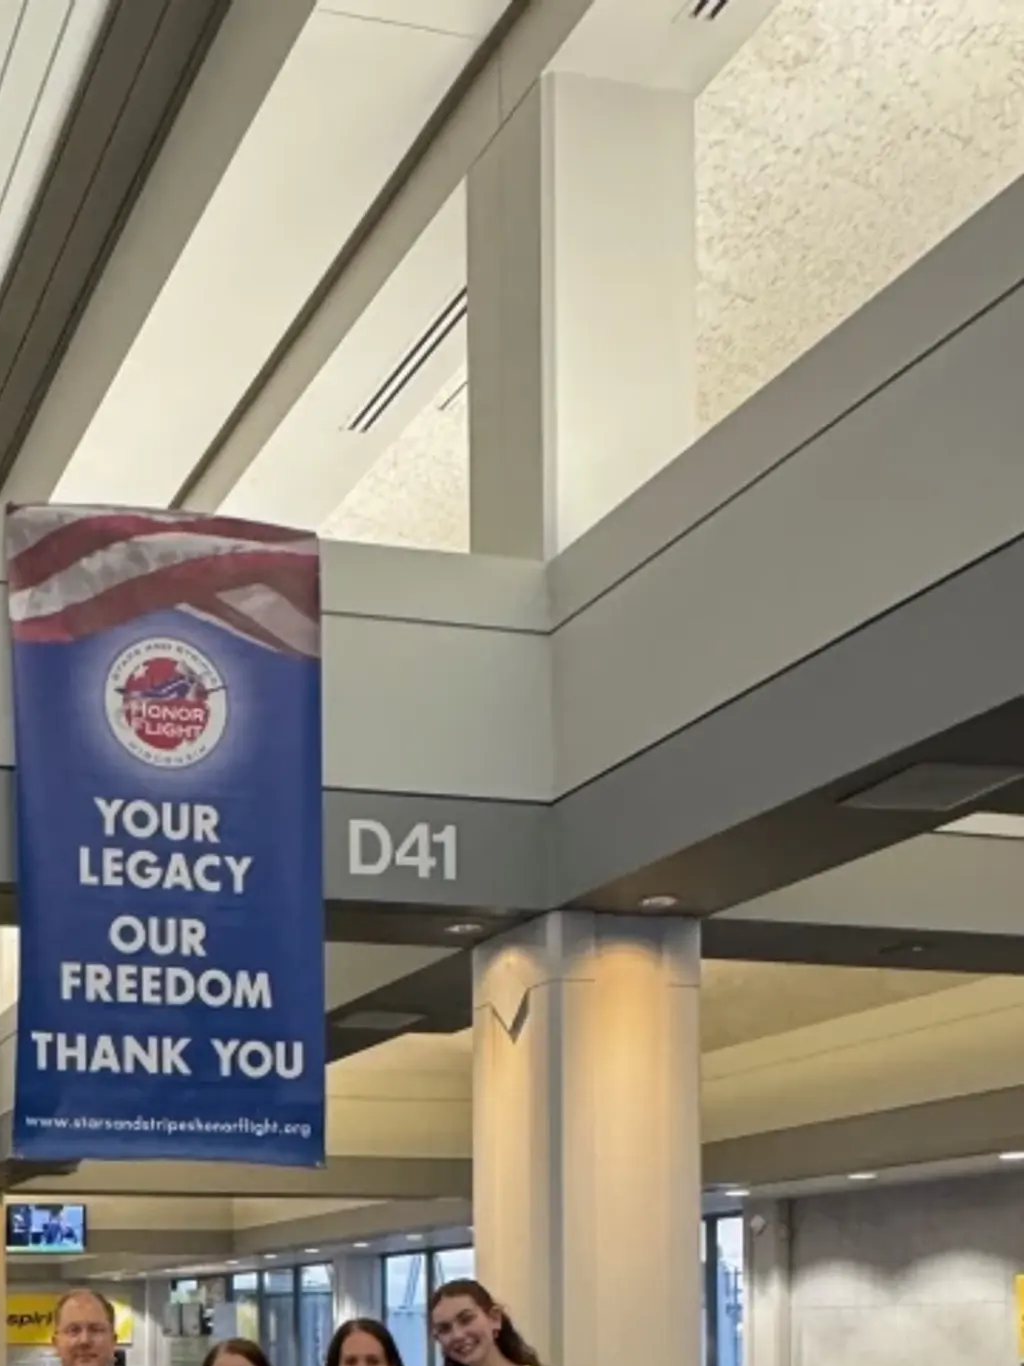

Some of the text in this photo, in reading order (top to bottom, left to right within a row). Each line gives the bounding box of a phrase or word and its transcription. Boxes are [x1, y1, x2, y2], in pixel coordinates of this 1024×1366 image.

[130, 700, 205, 722] HONOR
[131, 718, 204, 739] FLIGHT
[94, 797, 220, 843] YOUR
[78, 846, 254, 894] LEGACY
[348, 818, 457, 880] D41
[108, 915, 207, 957] OUR
[60, 962, 273, 1009] FREEDOM
[30, 1031, 305, 1080] THANK YOU
